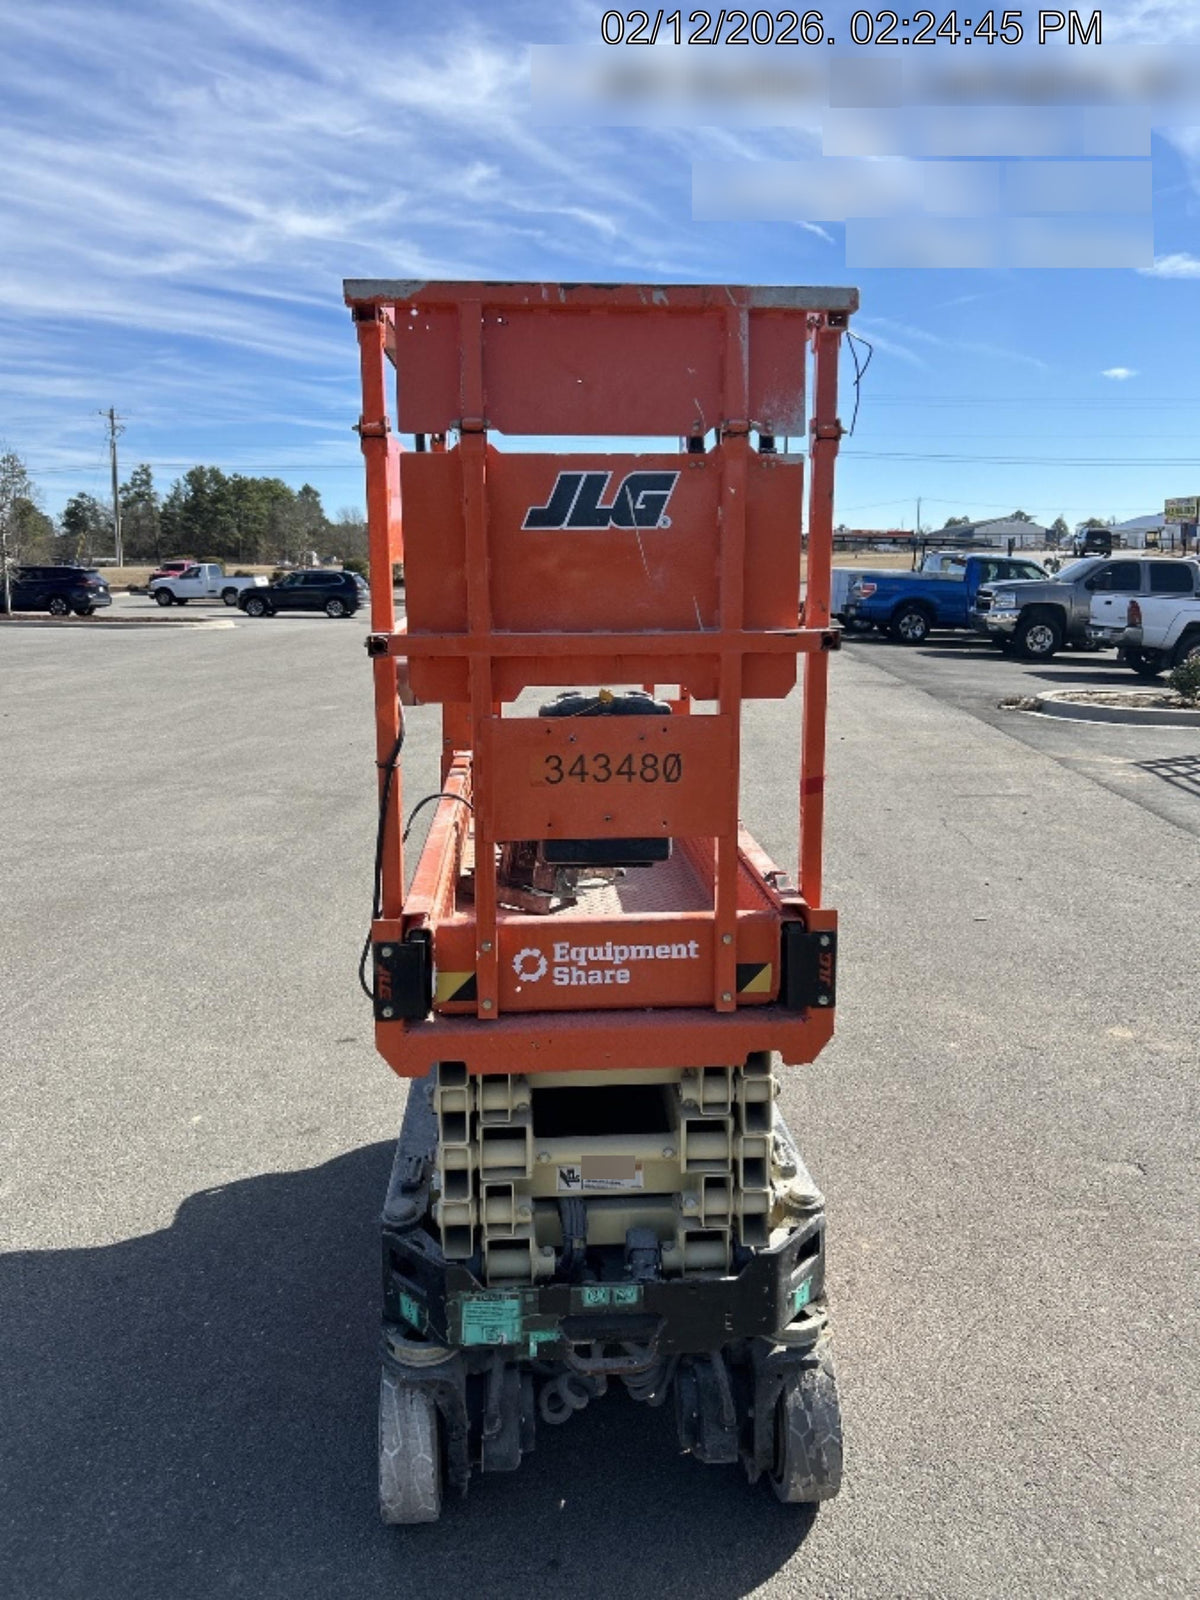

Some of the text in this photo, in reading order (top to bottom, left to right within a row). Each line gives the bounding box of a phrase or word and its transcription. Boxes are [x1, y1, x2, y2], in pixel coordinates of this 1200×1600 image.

[521, 471, 681, 530] JLG
[544, 753, 682, 785] 343480
[553, 940, 700, 966] Equipment
[553, 966, 631, 986] Share
